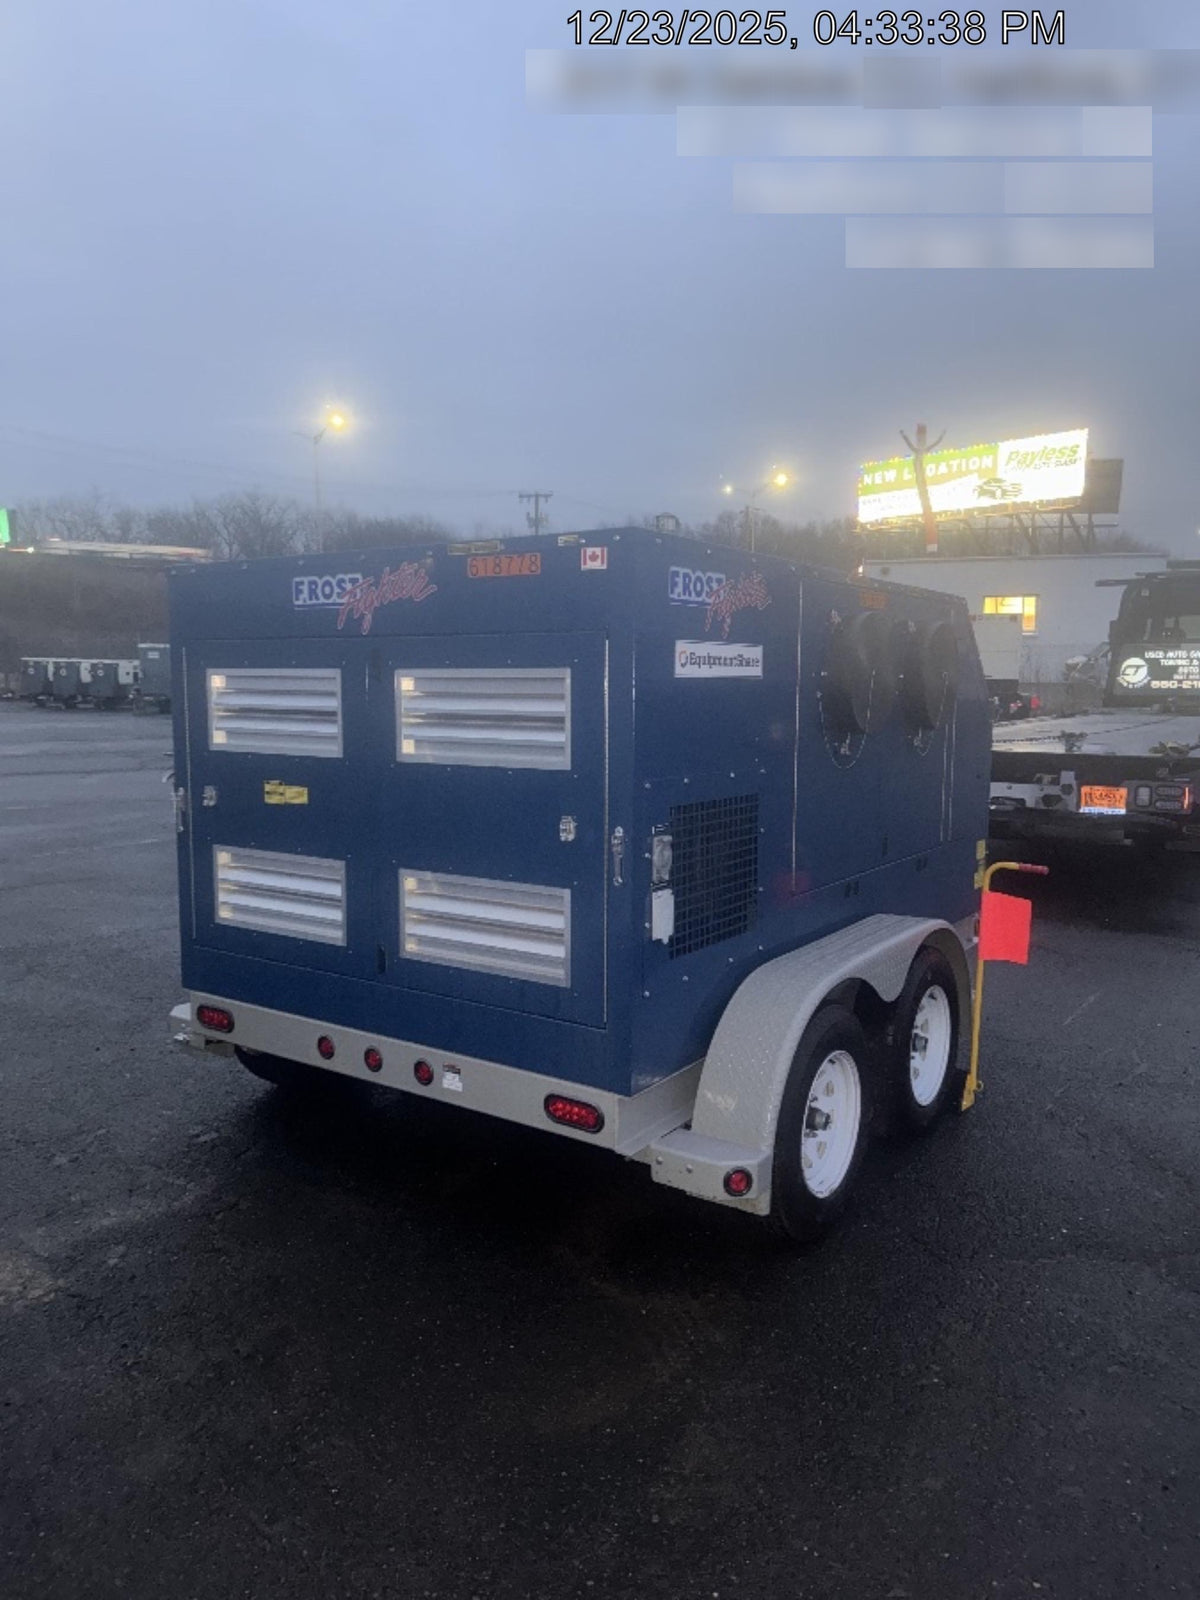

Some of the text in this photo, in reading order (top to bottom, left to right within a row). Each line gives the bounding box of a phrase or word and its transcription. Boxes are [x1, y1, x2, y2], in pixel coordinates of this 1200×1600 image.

[863, 468, 898, 487] NEW
[902, 454, 994, 481] LCATION
[1004, 443, 1081, 469] Payless
[292, 573, 363, 606] FROST
[668, 565, 726, 605] FROST
[689, 651, 760, 669] EquipmentShare
